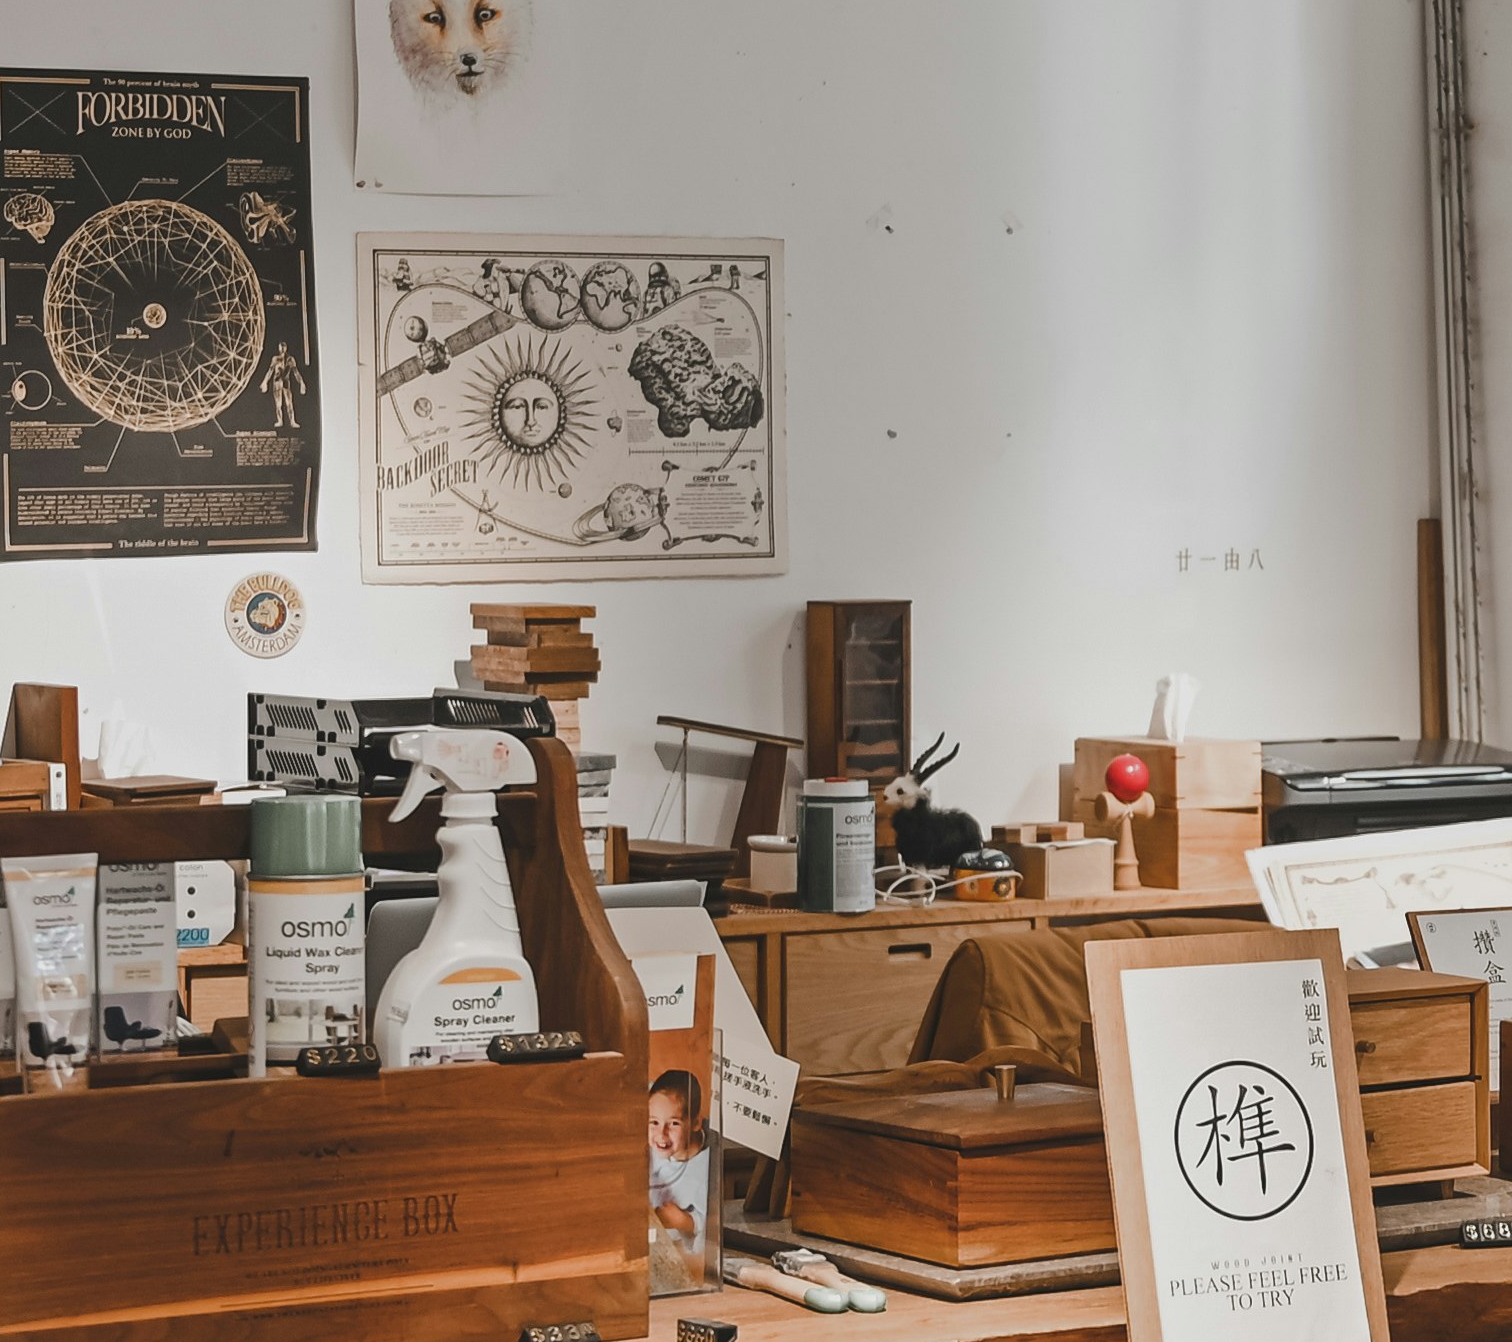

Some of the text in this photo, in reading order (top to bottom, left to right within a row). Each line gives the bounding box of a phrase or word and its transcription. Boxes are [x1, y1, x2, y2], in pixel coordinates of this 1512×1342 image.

[76, 91, 226, 138] FORBIDDEN
[112, 126, 192, 139] ZONE BY GOD
[377, 441, 449, 490] BACKDOOR
[431, 460, 477, 498] SECRET
[230, 574, 303, 613] THE BULLDOG
[232, 622, 302, 653] AMSTERDAM
[281, 920, 347, 938] osmo
[266, 946, 301, 960] Liquid
[305, 947, 330, 958] Wax
[306, 963, 339, 975] Spray
[452, 996, 496, 1010] osmo
[648, 995, 678, 1007] smo
[434, 1014, 516, 1028] Spray Cleaner
[1301, 979, 1327, 1069] 歡迎試玩
[306, 1046, 377, 1064] $220
[1195, 1083, 1296, 1196] 榫
[193, 1193, 459, 1256] EXPERIENCE BOX
[1210, 1253, 1305, 1271] WOOD JOINT
[1169, 1262, 1348, 1298] PLEASE FEEL FREE
[1226, 1287, 1295, 1312] TO TRY
